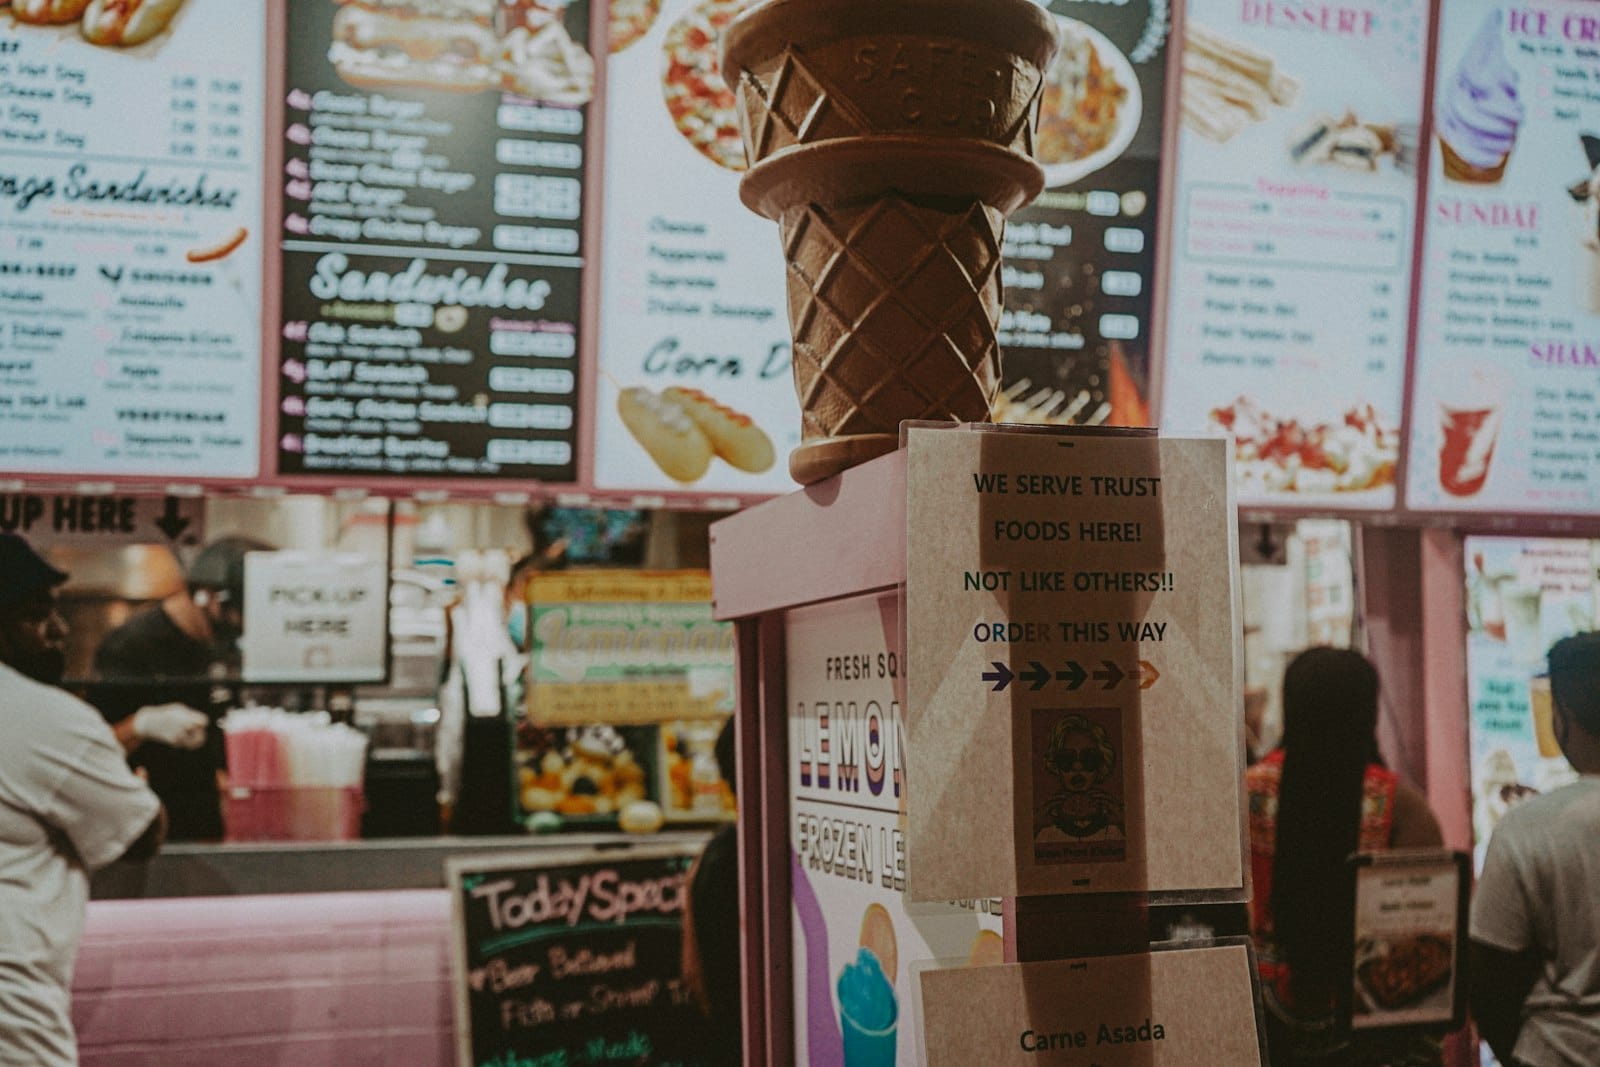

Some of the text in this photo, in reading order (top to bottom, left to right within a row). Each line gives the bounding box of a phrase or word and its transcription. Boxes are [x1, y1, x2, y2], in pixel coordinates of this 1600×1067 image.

[1241, 0, 1374, 37] DESSERT
[310, 252, 551, 311] Sandwiches
[643, 336, 743, 378] Corn
[973, 473, 1161, 497] WE SERVE TRUST
[0, 496, 136, 533] UP HERE
[994, 520, 1142, 542] FOODS HERE!
[963, 570, 1174, 593] NOT LIKE OTHERS!!
[284, 617, 350, 637] HERE
[973, 622, 1168, 643] ORDER THIS WAY
[826, 653, 871, 681] FRESH
[797, 812, 874, 885] FROZEN
[1020, 1017, 1166, 1053] Carne Asada
